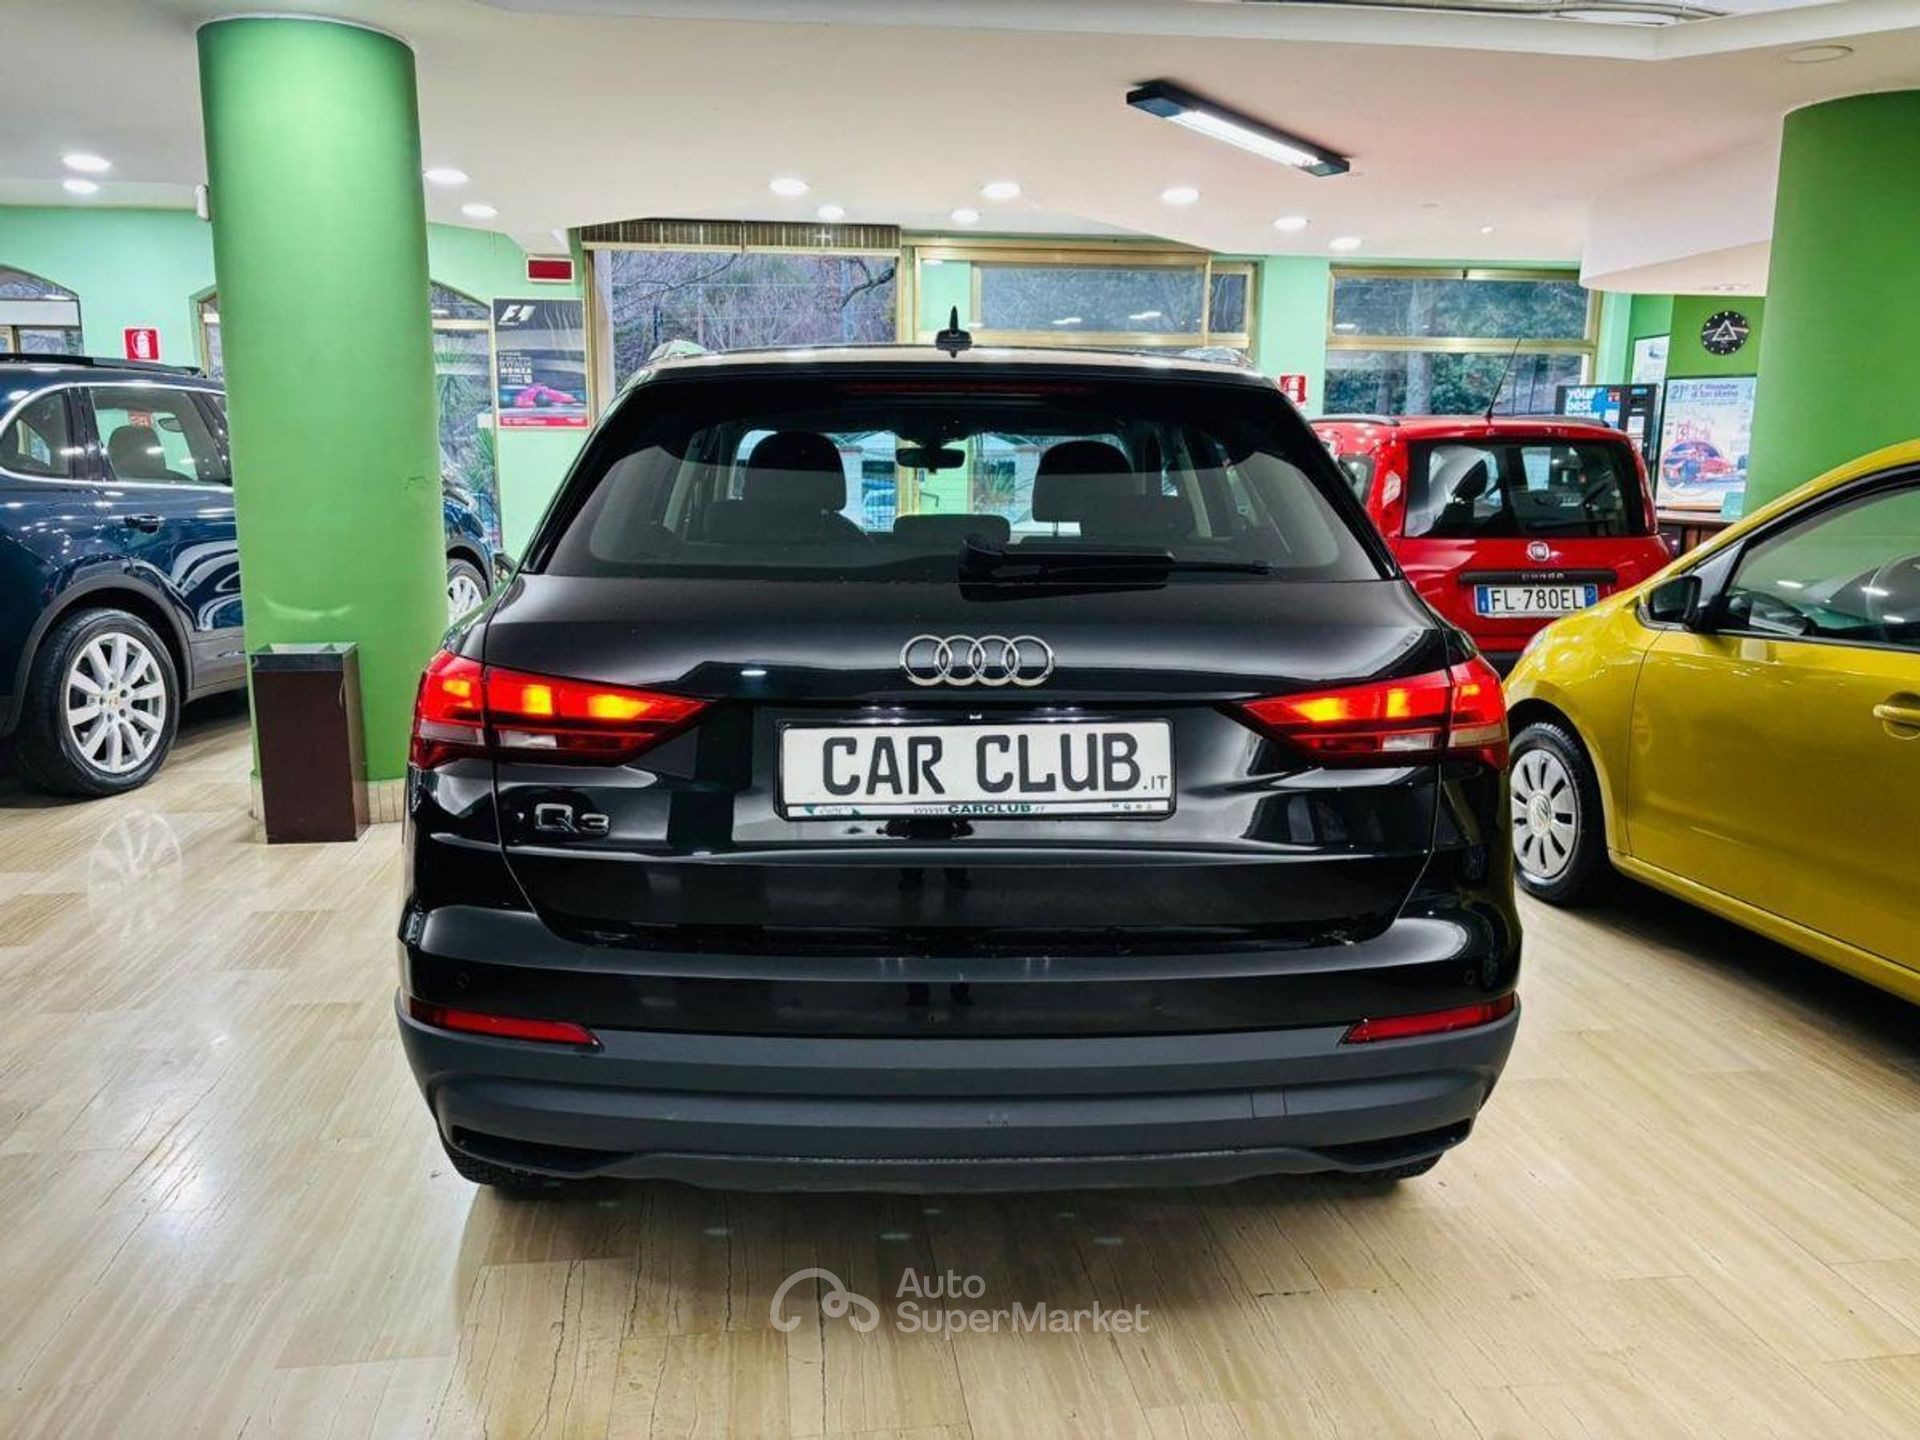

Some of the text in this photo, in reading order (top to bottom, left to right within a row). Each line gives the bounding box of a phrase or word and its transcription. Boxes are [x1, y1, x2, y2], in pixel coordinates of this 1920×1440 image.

[1490, 588, 1583, 611] FL 780EL
[822, 736, 946, 796] CAR
[535, 802, 610, 835] Q3
